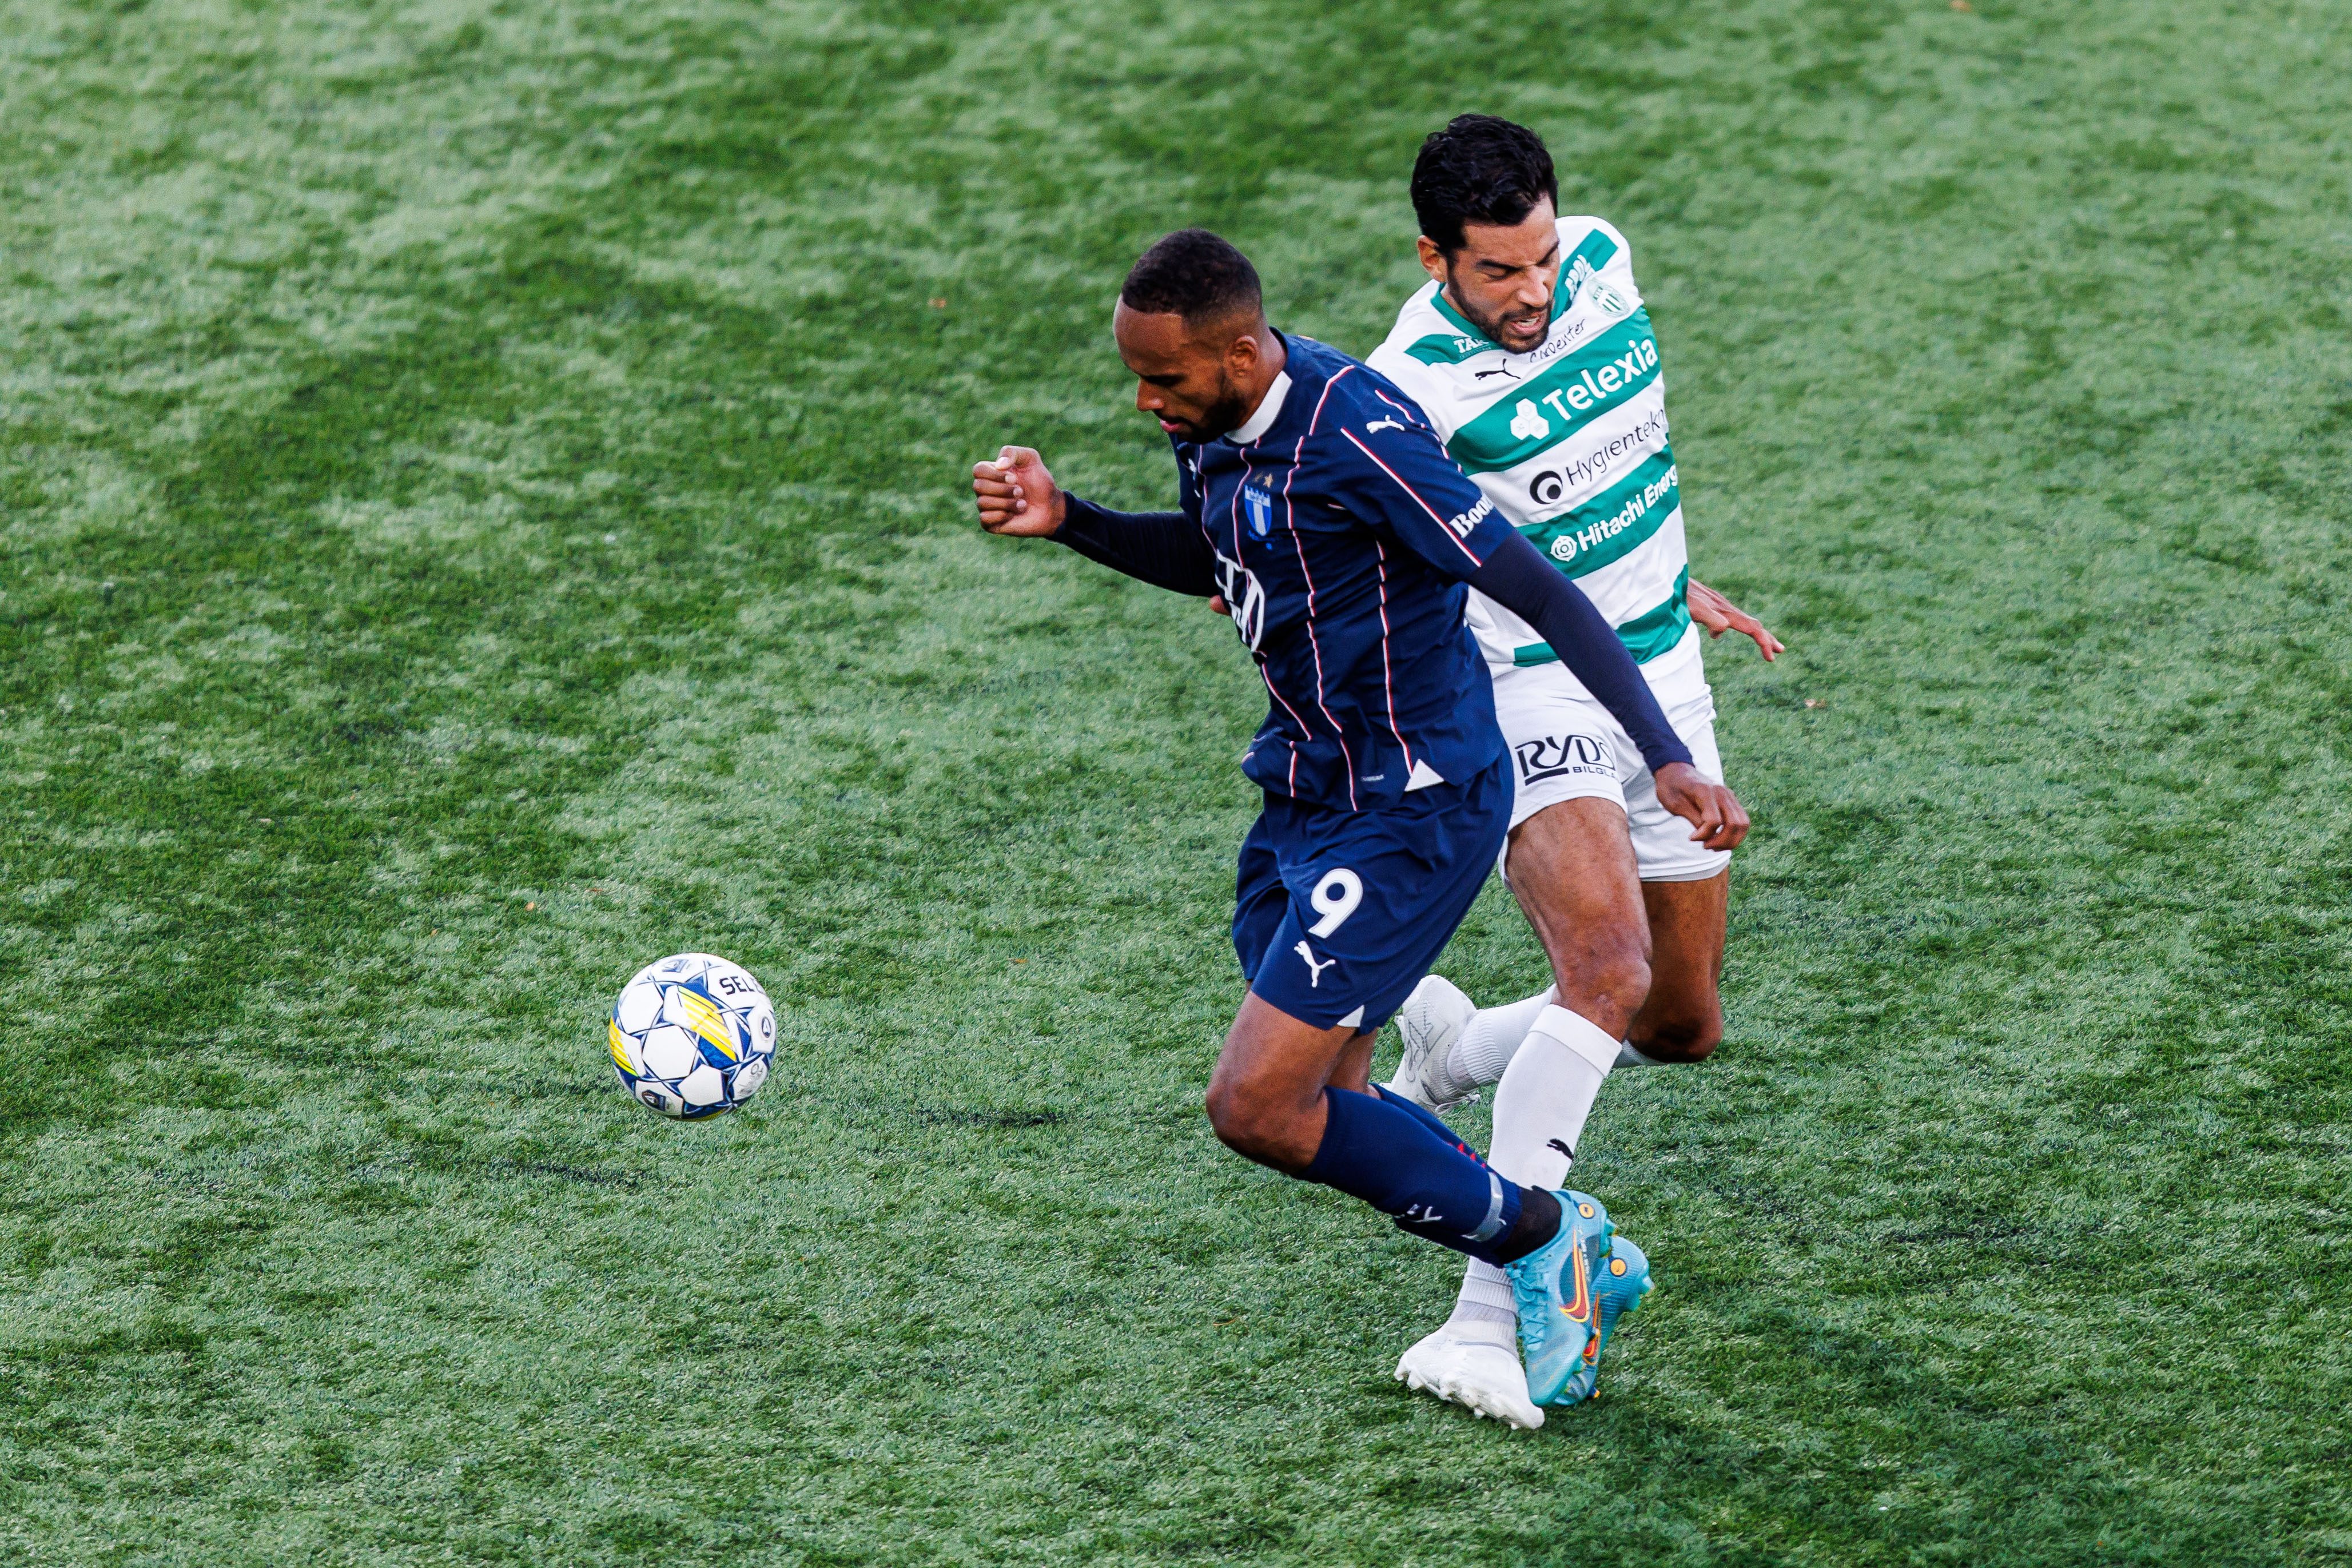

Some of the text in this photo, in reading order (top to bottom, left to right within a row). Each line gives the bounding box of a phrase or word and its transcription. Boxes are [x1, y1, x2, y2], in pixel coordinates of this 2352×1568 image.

[1542, 339, 1658, 420] Telexia
[1576, 494, 1645, 552] Hitachi
[1308, 867, 1363, 939] 9
